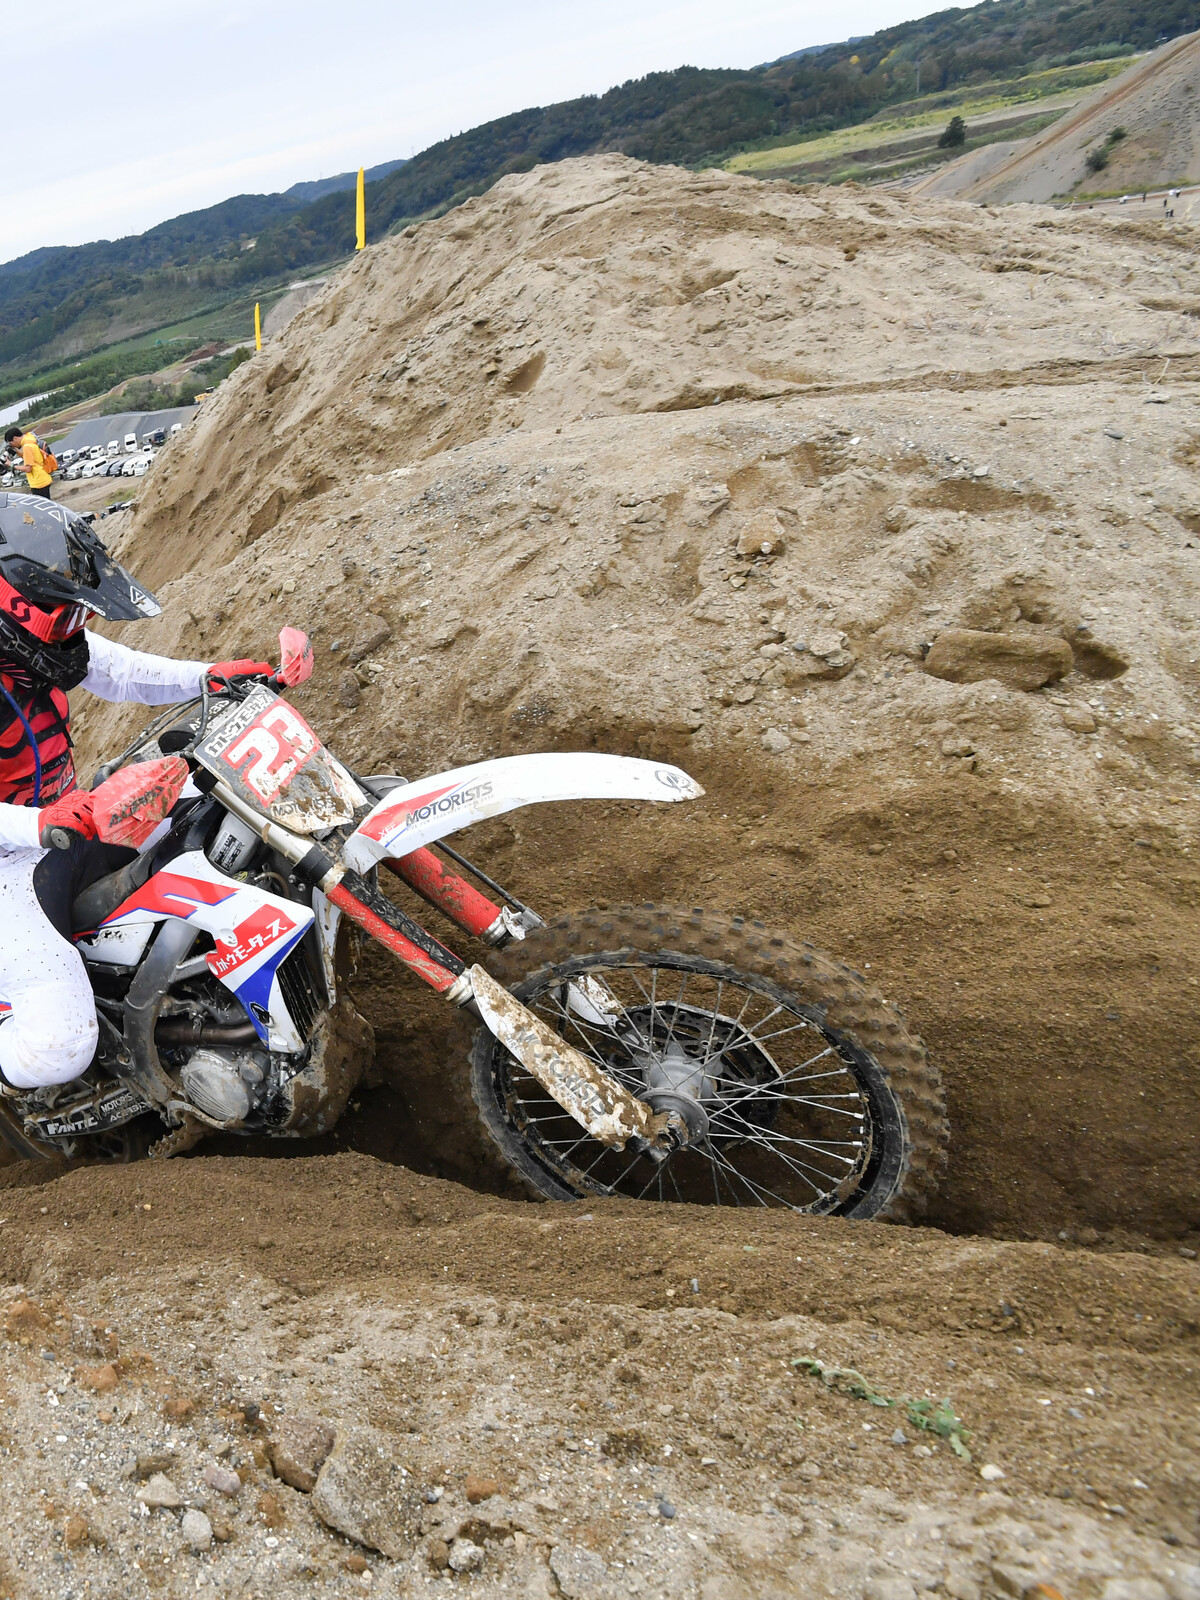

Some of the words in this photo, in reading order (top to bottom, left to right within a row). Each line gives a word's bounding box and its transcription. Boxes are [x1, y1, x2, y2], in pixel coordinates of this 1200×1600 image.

[227, 705, 315, 798] 23
[273, 796, 336, 818] MOTISTS
[405, 781, 493, 827] MOTORISTS
[46, 1116, 99, 1135] FANTIC
